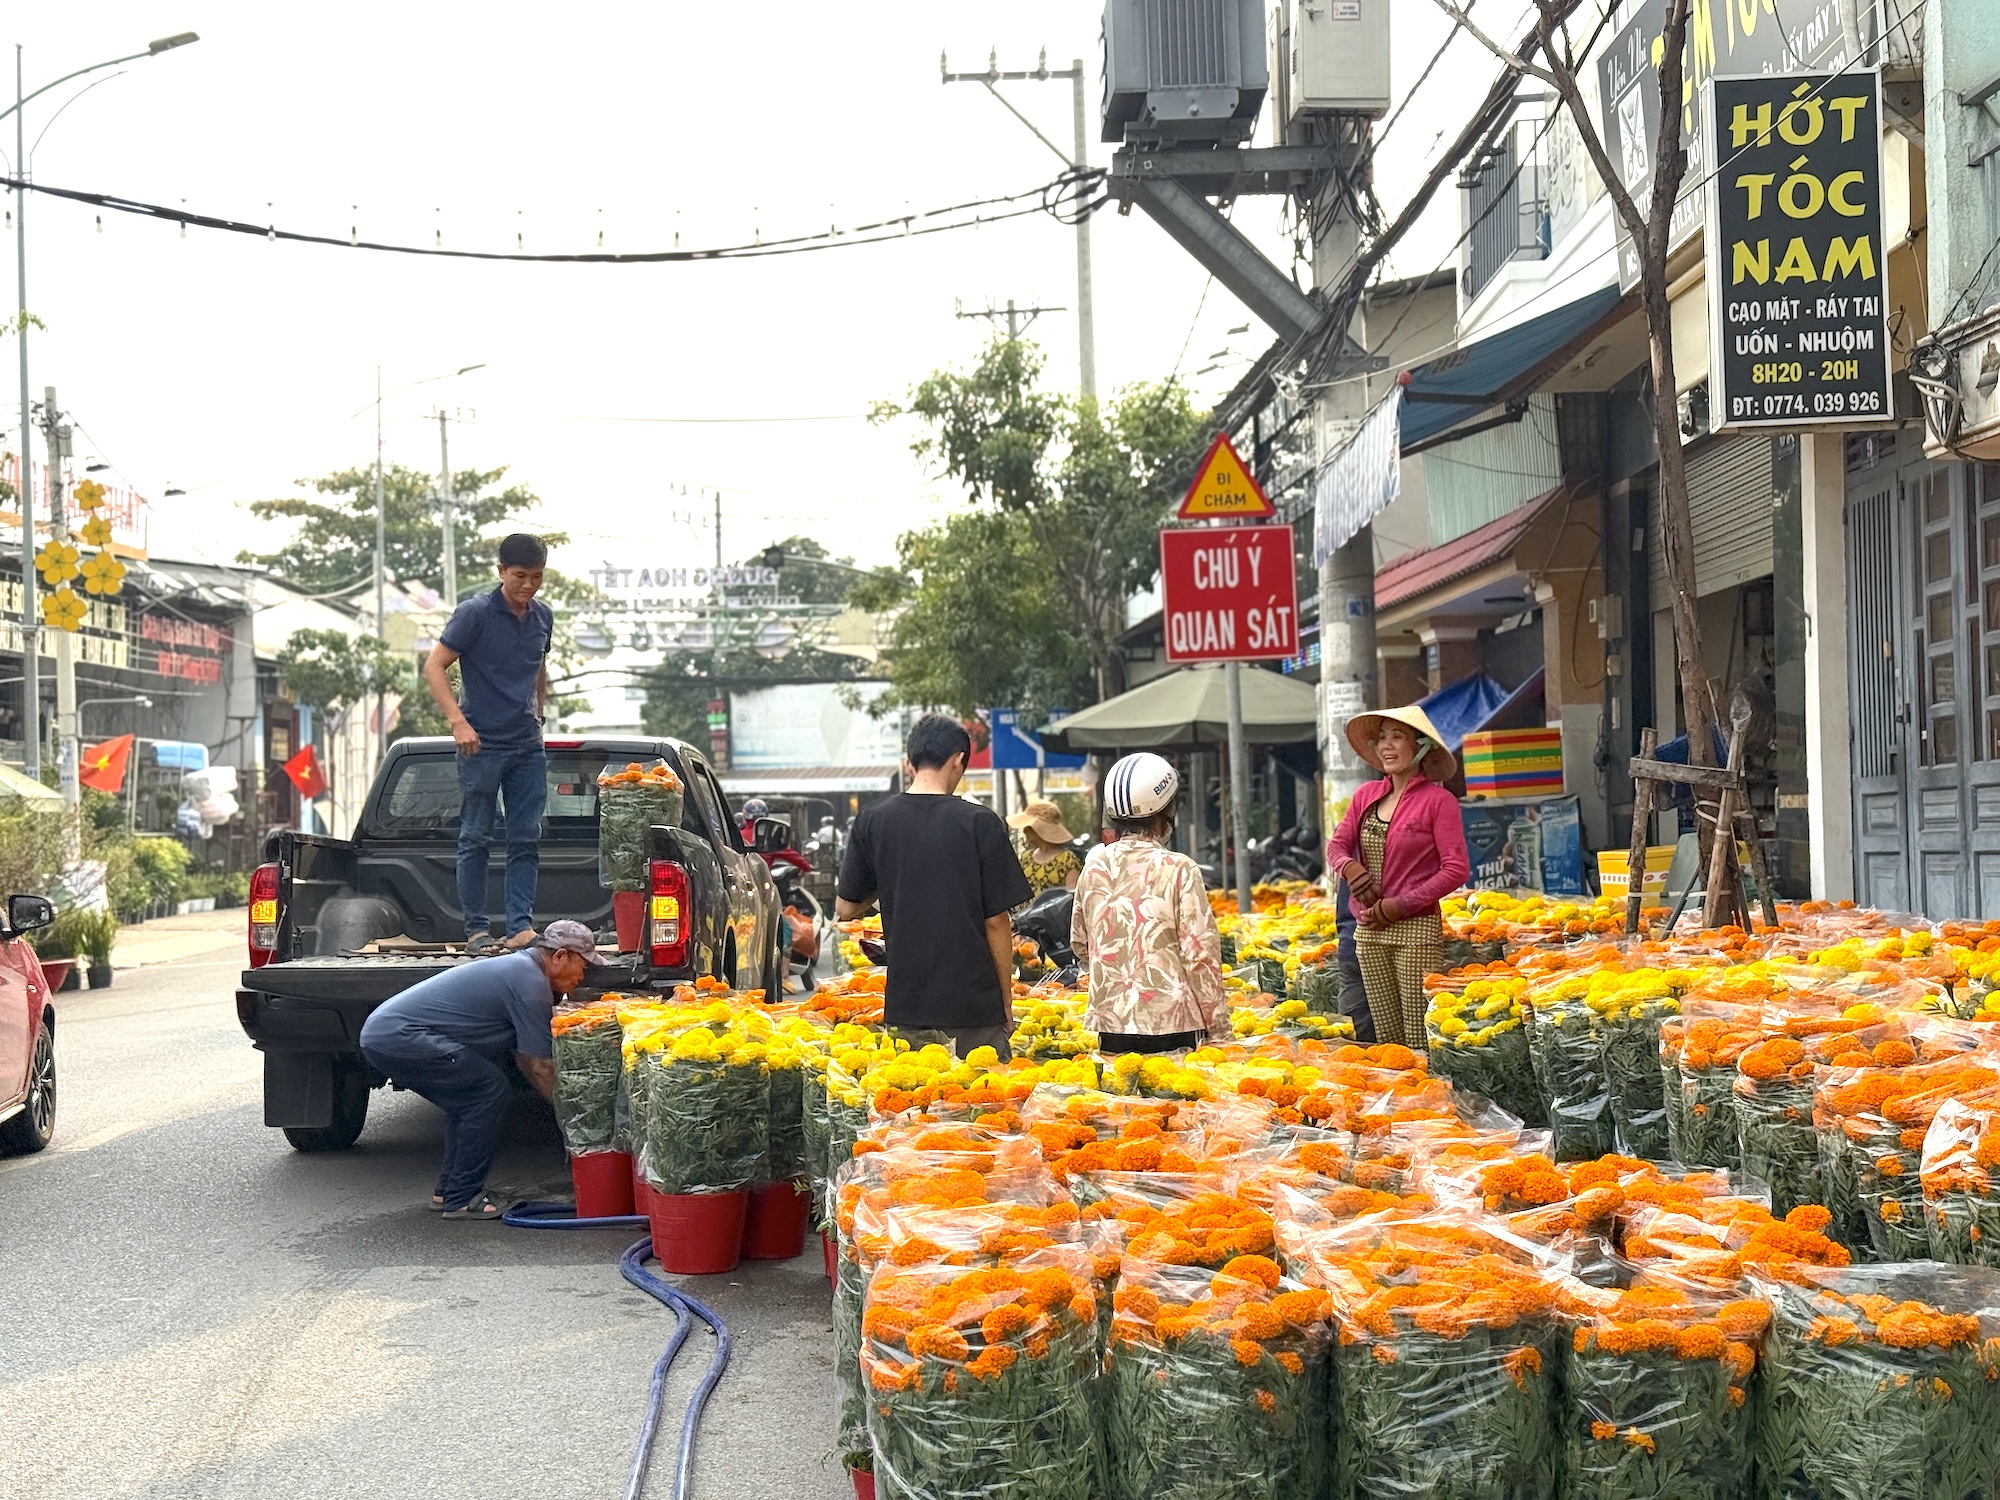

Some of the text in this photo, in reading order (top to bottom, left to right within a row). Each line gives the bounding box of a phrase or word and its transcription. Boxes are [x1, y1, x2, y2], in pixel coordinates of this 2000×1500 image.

[1686, 126, 1700, 171] UỐ
[1806, 5, 1830, 54] RÁY
[1728, 81, 1869, 149] HỚT
[1735, 154, 1867, 221] TÓC
[1732, 235, 1877, 286] NAM
[1728, 301, 1761, 326] CẠO
[1766, 296, 1800, 326] MẶT
[1816, 293, 1848, 319] RÁY
[1853, 296, 1879, 317] TAI
[1735, 326, 1779, 356] UỐN
[1798, 325, 1875, 355] NHUỘM
[1752, 362, 1802, 384] 8H20
[1821, 359, 1859, 381] 20H
[1732, 390, 1880, 417] ĐT: 0774. 039 926
[1216, 472, 1231, 486] ĐI
[1203, 490, 1247, 509] CHẬM
[1192, 533, 1263, 590] CHÚ Ý
[1170, 594, 1291, 654] QUAN SÁT
[1153, 776, 1169, 796] BIDV
[1474, 872, 1513, 890] NGAY
